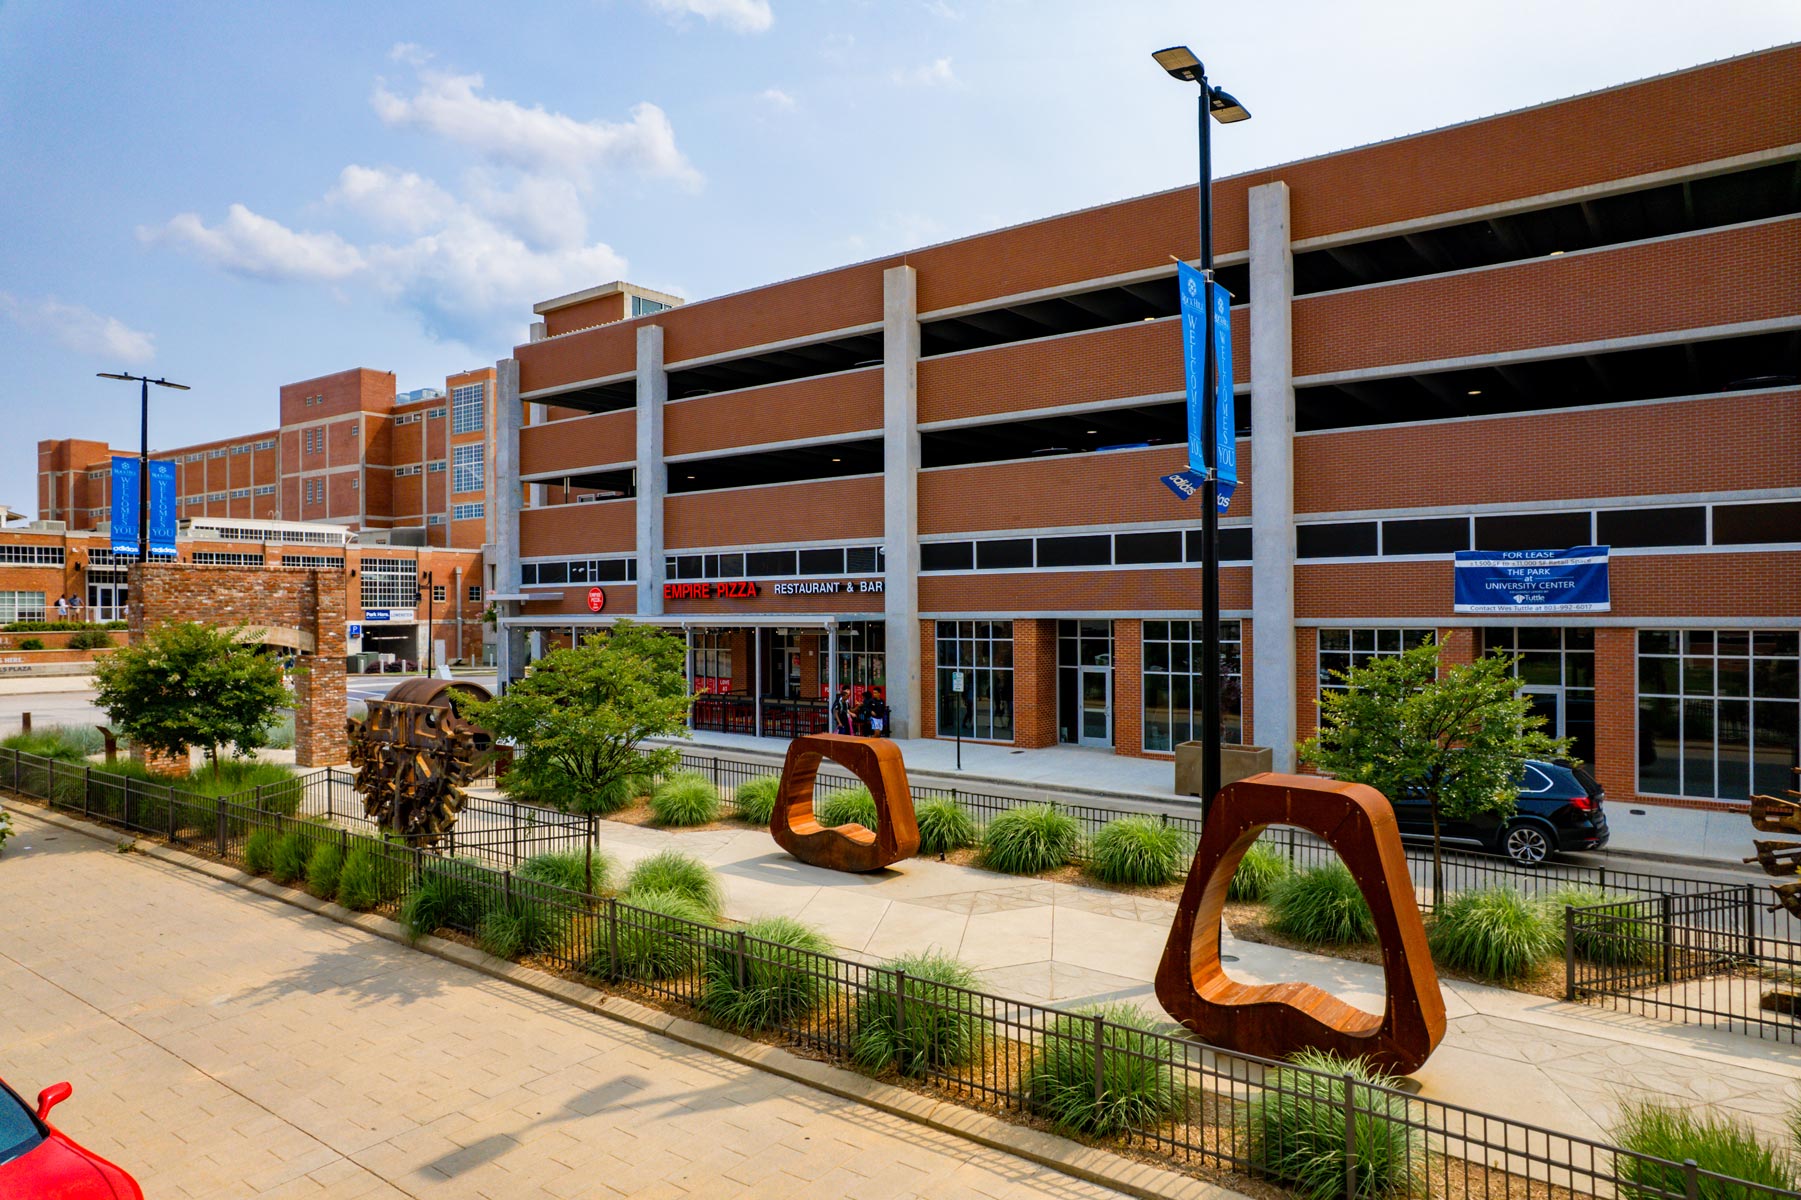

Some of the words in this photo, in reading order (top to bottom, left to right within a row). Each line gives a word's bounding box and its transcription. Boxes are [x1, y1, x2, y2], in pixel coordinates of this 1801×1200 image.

[1218, 446, 1235, 467] YOU
[1169, 474, 1197, 496] adidas
[113, 526, 136, 535] YOU
[151, 528, 174, 537] YOU
[113, 545, 139, 553] adidas
[151, 546, 177, 554] adidas
[1525, 551, 1555, 559] LEASE
[1507, 568, 1525, 576] THE
[1527, 568, 1551, 576] PARK
[663, 582, 711, 599] EMPIRE
[717, 581, 757, 598] PIZZA
[774, 582, 841, 594] RESTAURANT
[846, 581, 854, 592] &
[860, 581, 883, 592] BAR
[1485, 582, 1536, 590] UNIVERSITY
[1538, 581, 1576, 589] CENTER
